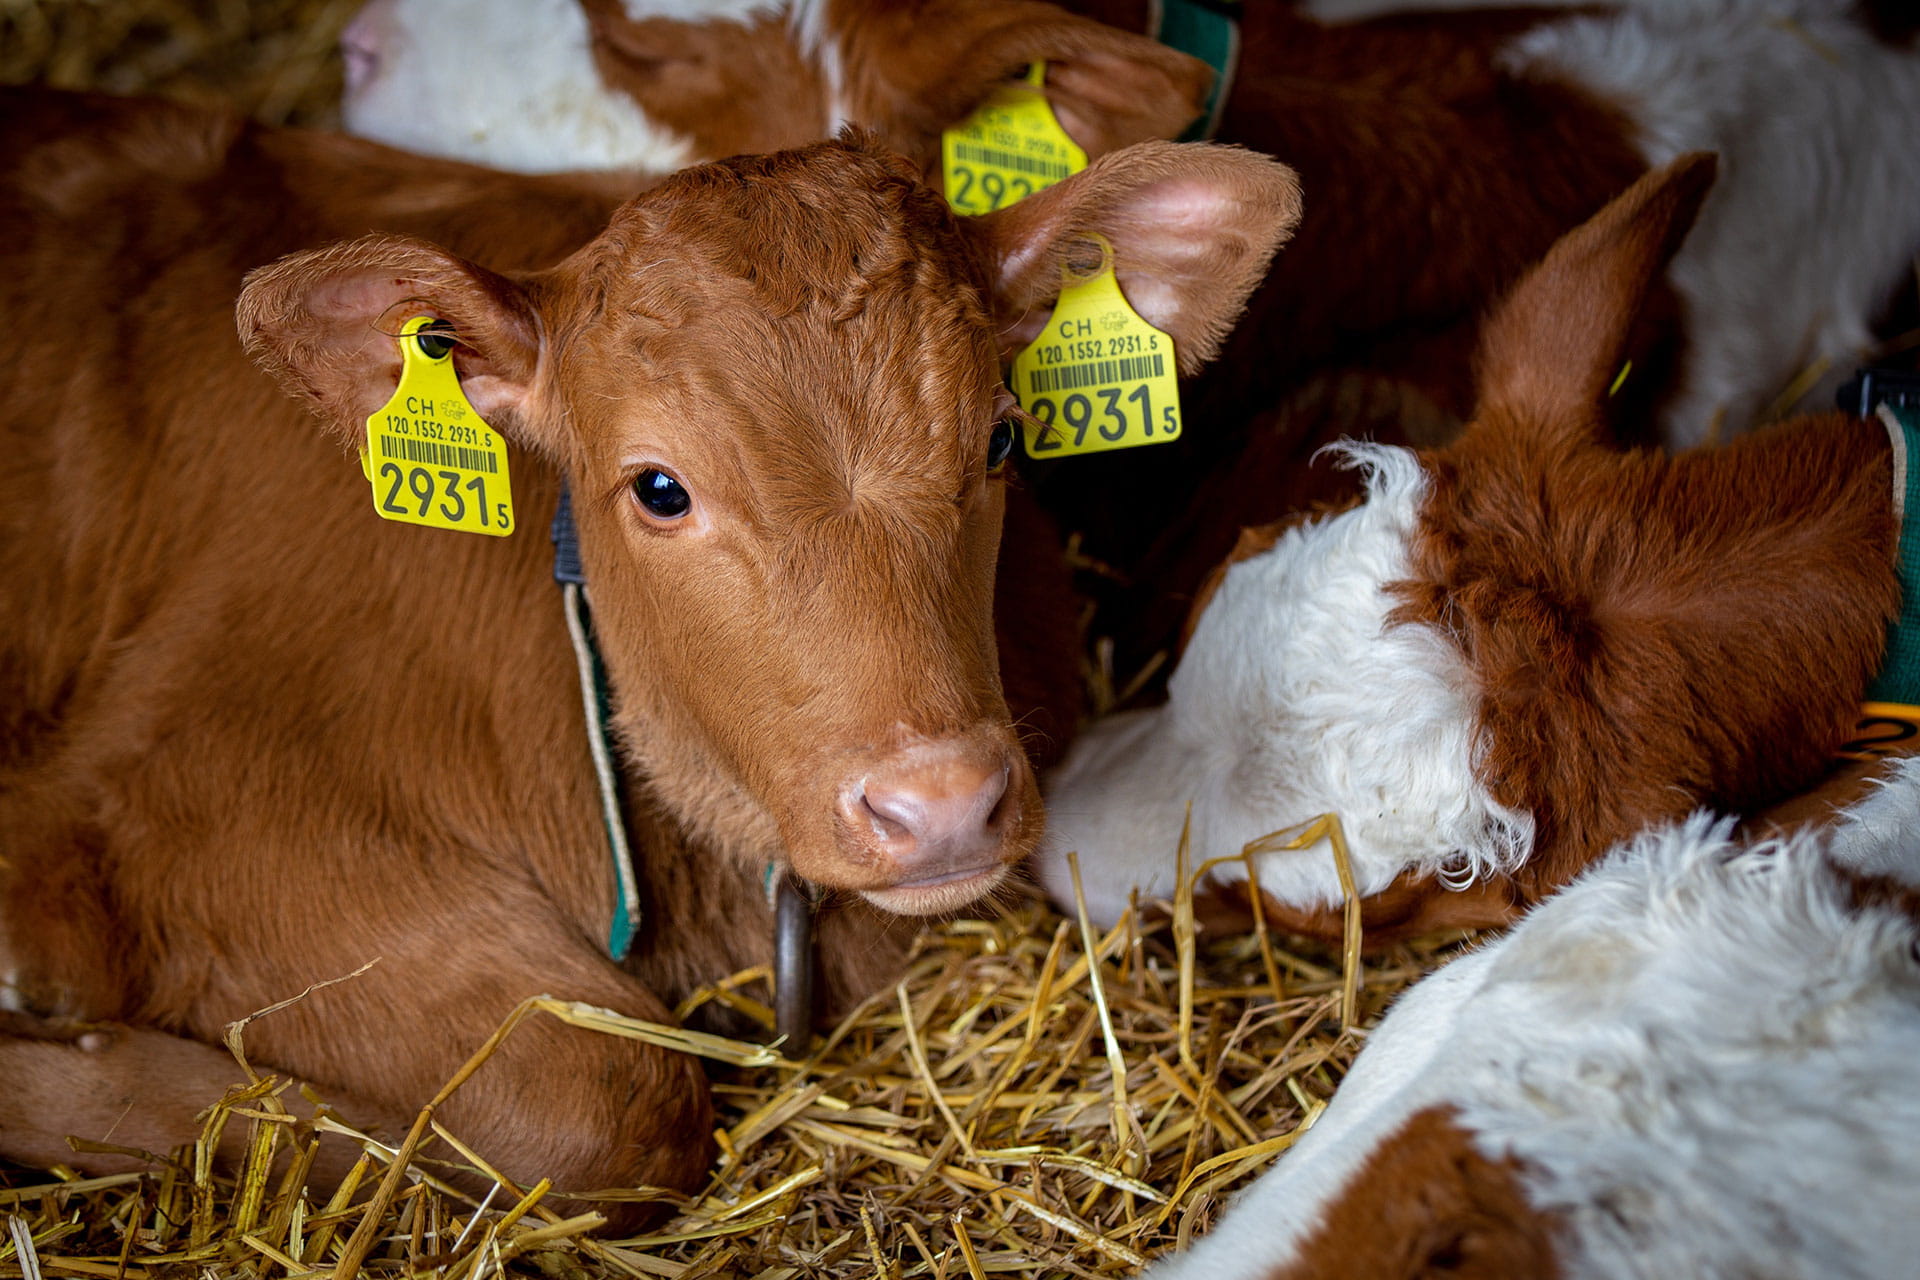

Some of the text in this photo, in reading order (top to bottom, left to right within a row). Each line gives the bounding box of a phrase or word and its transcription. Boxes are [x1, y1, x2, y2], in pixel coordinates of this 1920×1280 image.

[952, 166, 1048, 210] 292
[1059, 318, 1092, 339] CH
[1036, 335, 1158, 365] 120.1552.2931.5
[406, 396, 434, 417] CH
[1031, 384, 1177, 452] 2931 5
[387, 415, 492, 447] 120.1552.2931.5
[380, 462, 510, 529] 2931 5
